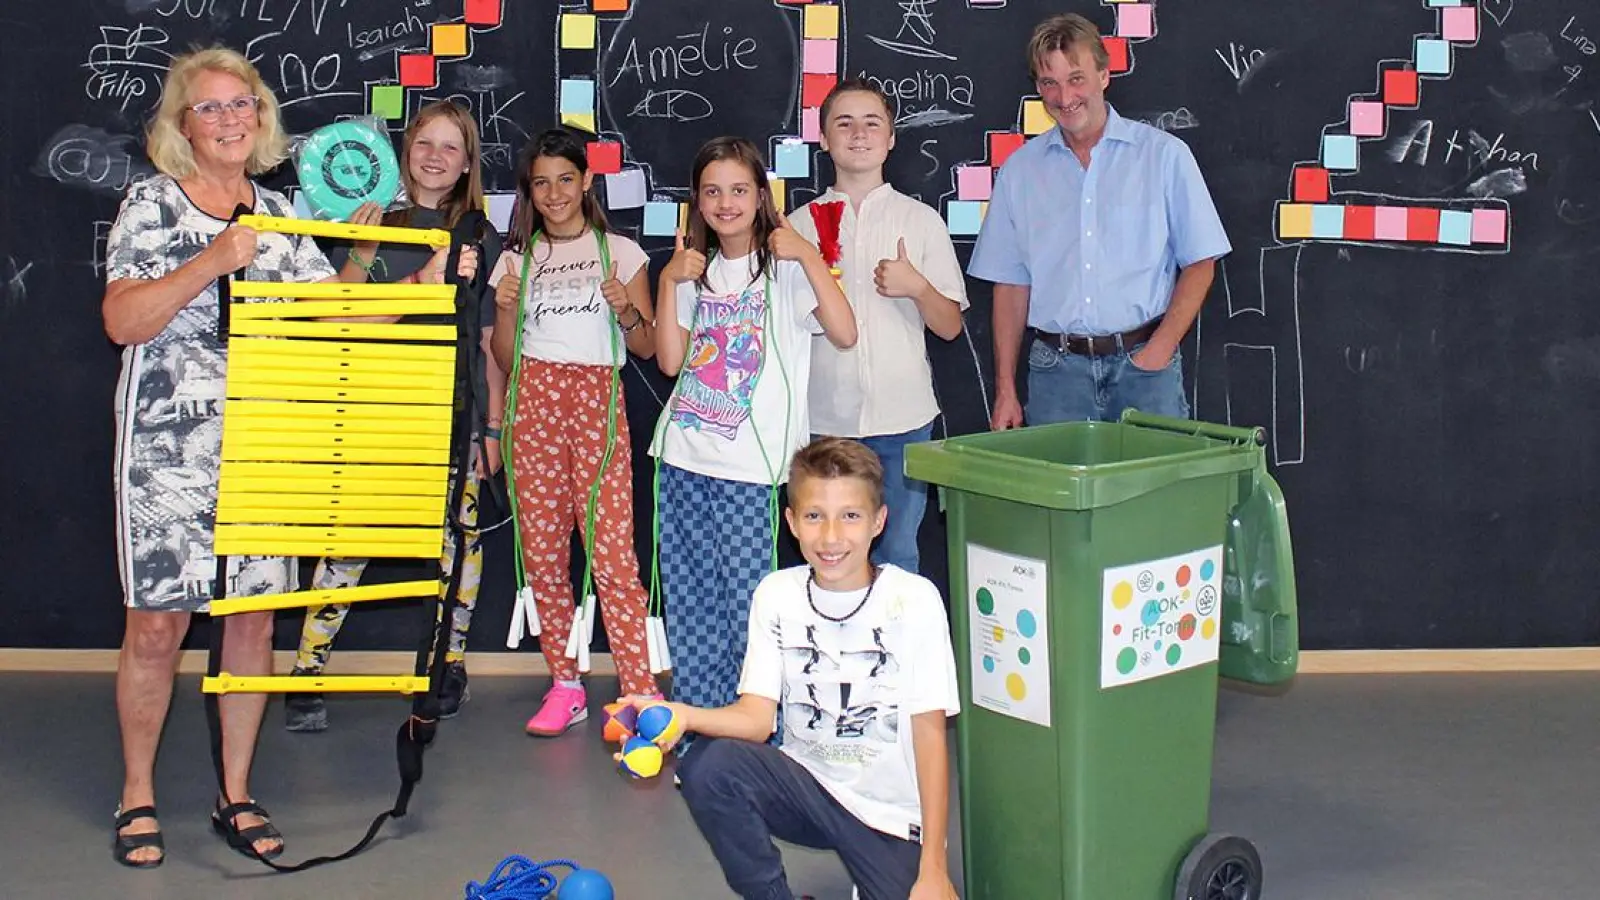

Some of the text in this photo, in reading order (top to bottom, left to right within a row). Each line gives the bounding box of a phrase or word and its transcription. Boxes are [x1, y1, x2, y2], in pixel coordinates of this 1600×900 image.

[347, 7, 424, 49] Isaiah
[1559, 16, 1597, 55] Lina
[533, 259, 600, 283] forever
[532, 292, 601, 328] friends
[1147, 595, 1185, 617] AOK-
